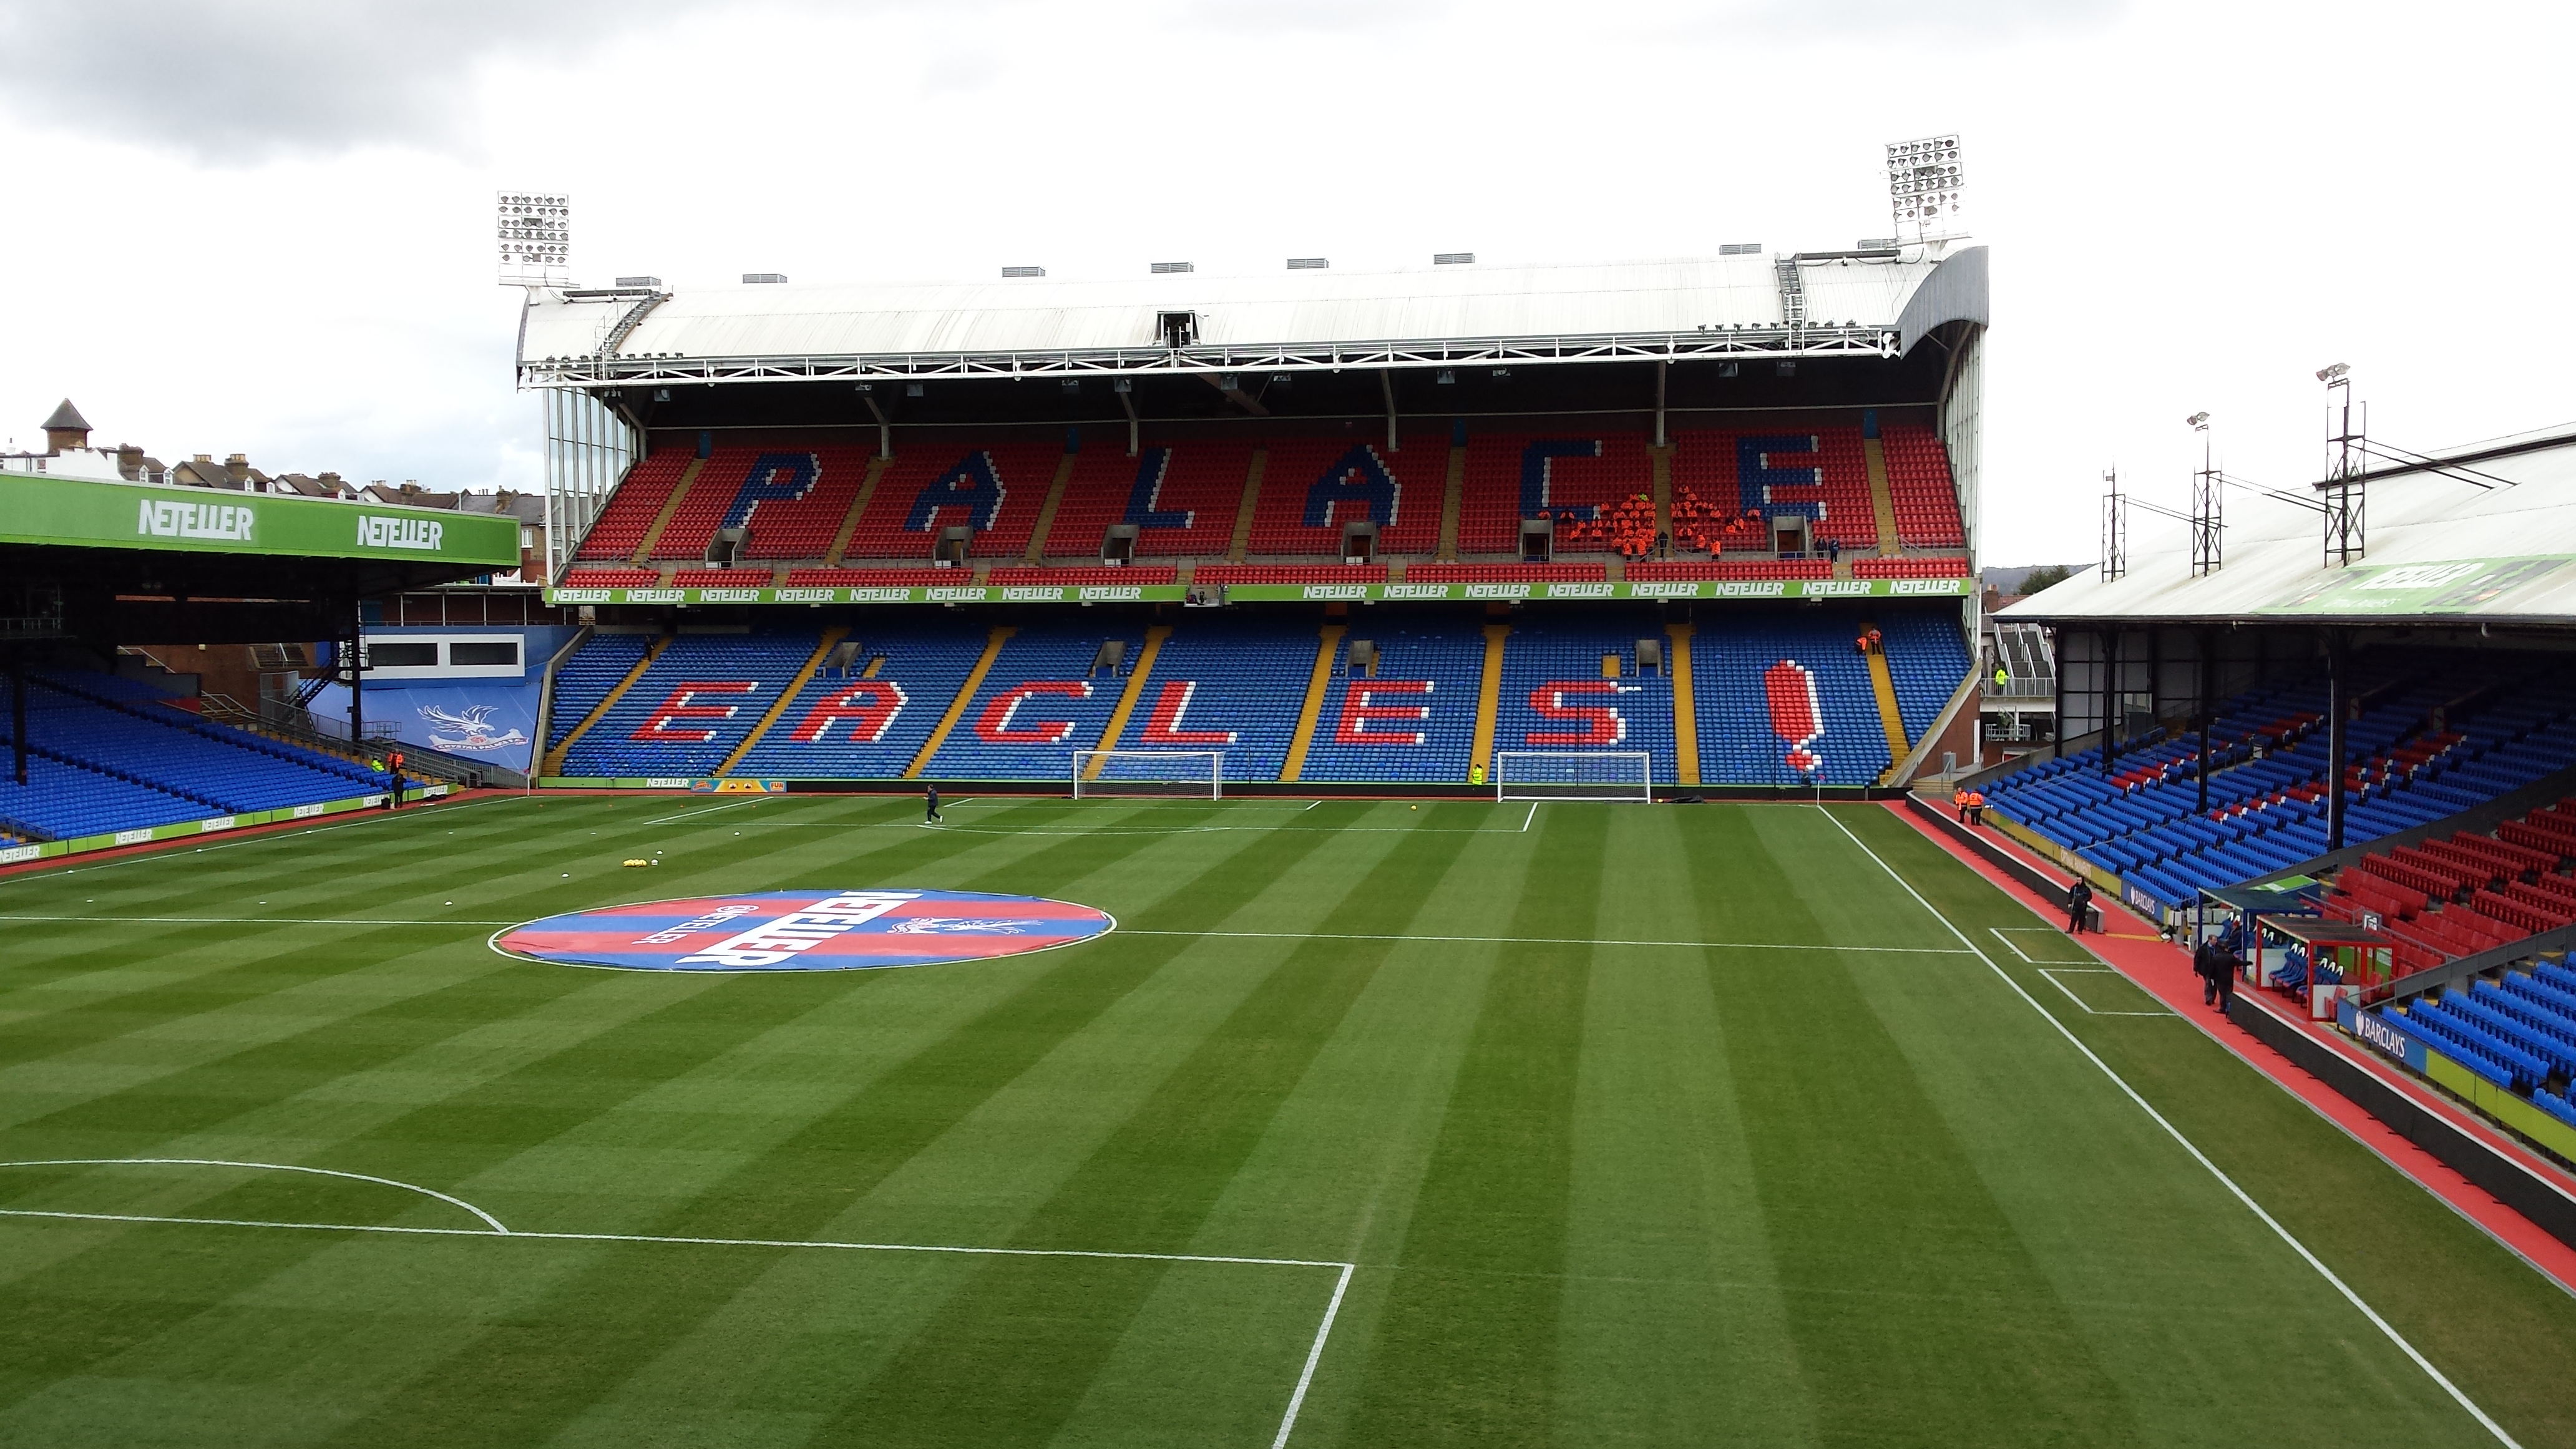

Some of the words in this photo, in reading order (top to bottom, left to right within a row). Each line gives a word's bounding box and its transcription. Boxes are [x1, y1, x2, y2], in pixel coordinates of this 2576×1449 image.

[139, 499, 254, 540] NETELLER
[357, 515, 444, 550] NETELLER
[849, 588, 910, 601] NETELLER
[925, 588, 987, 601] NETELLER
[1002, 587, 1064, 600] NETELLER
[1078, 587, 1142, 600] NETELLER
[1303, 585, 1367, 599] NETELLER
[1383, 585, 1449, 598] NETELLER
[1465, 584, 1531, 598] NETELLER
[1547, 583, 1614, 597] NETELLER
[1631, 583, 1699, 597] NETELLER
[1715, 582, 1785, 596] NETELLER
[1801, 581, 1872, 595] NETELLER
[1889, 580, 1961, 595] NETELLER
[552, 589, 612, 602] NETELLER
[625, 588, 685, 602] NETELLER
[700, 588, 760, 602] NETELLER
[774, 588, 835, 602] NETELLER
[646, 778, 690, 788] NETELLER
[423, 785, 448, 798] NETELLER
[293, 804, 324, 817] NETELLER
[201, 816, 235, 832] NETELLER
[115, 829, 153, 844] NETELLER
[2135, 890, 2155, 915] BARCLAYS
[675, 891, 924, 966] NETELLER
[2365, 1017, 2406, 1058] BARCLAYS
